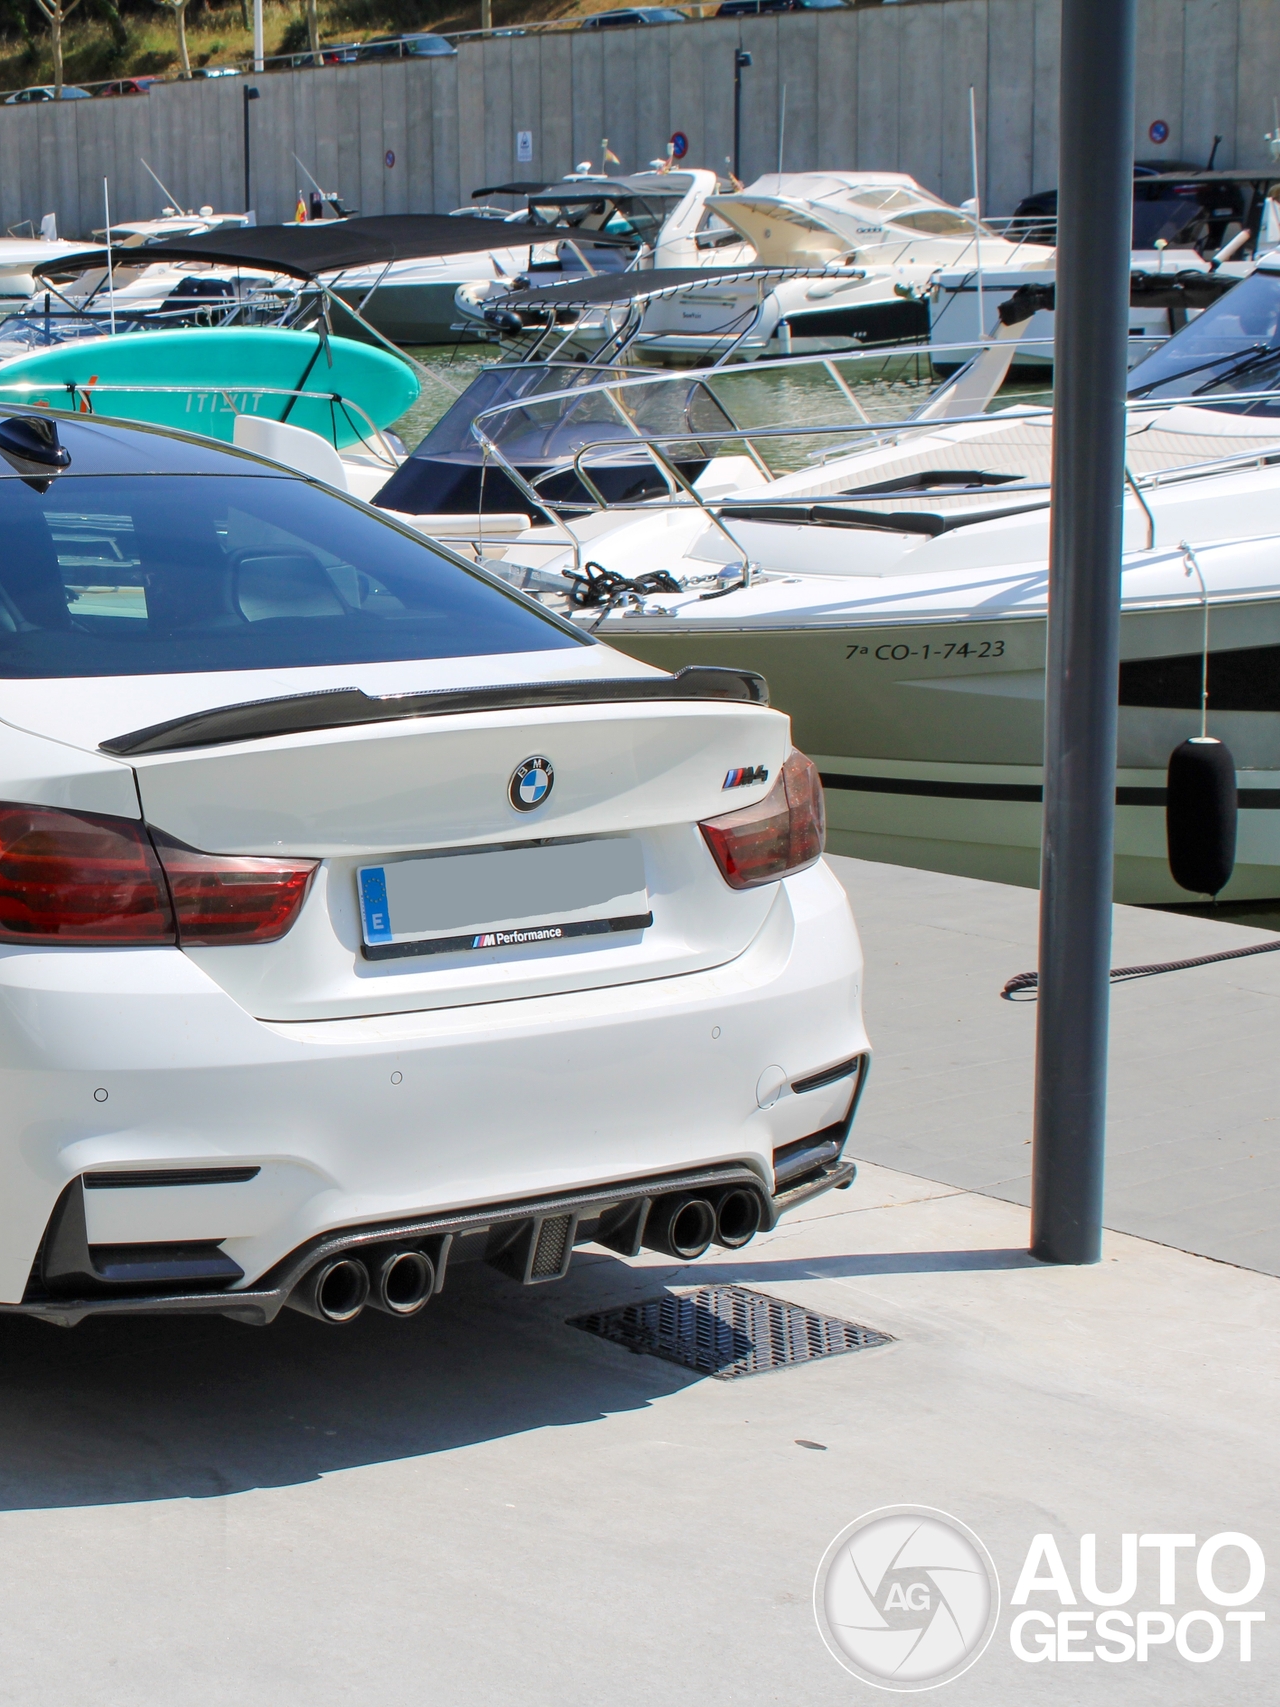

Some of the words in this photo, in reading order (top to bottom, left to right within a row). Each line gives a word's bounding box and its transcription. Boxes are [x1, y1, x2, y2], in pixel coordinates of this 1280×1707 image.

[874, 640, 1006, 661] CO-1-74-23
[517, 758, 553, 778] BMW
[737, 764, 769, 787] M4
[371, 913, 384, 930] E
[497, 927, 562, 945] Performance
